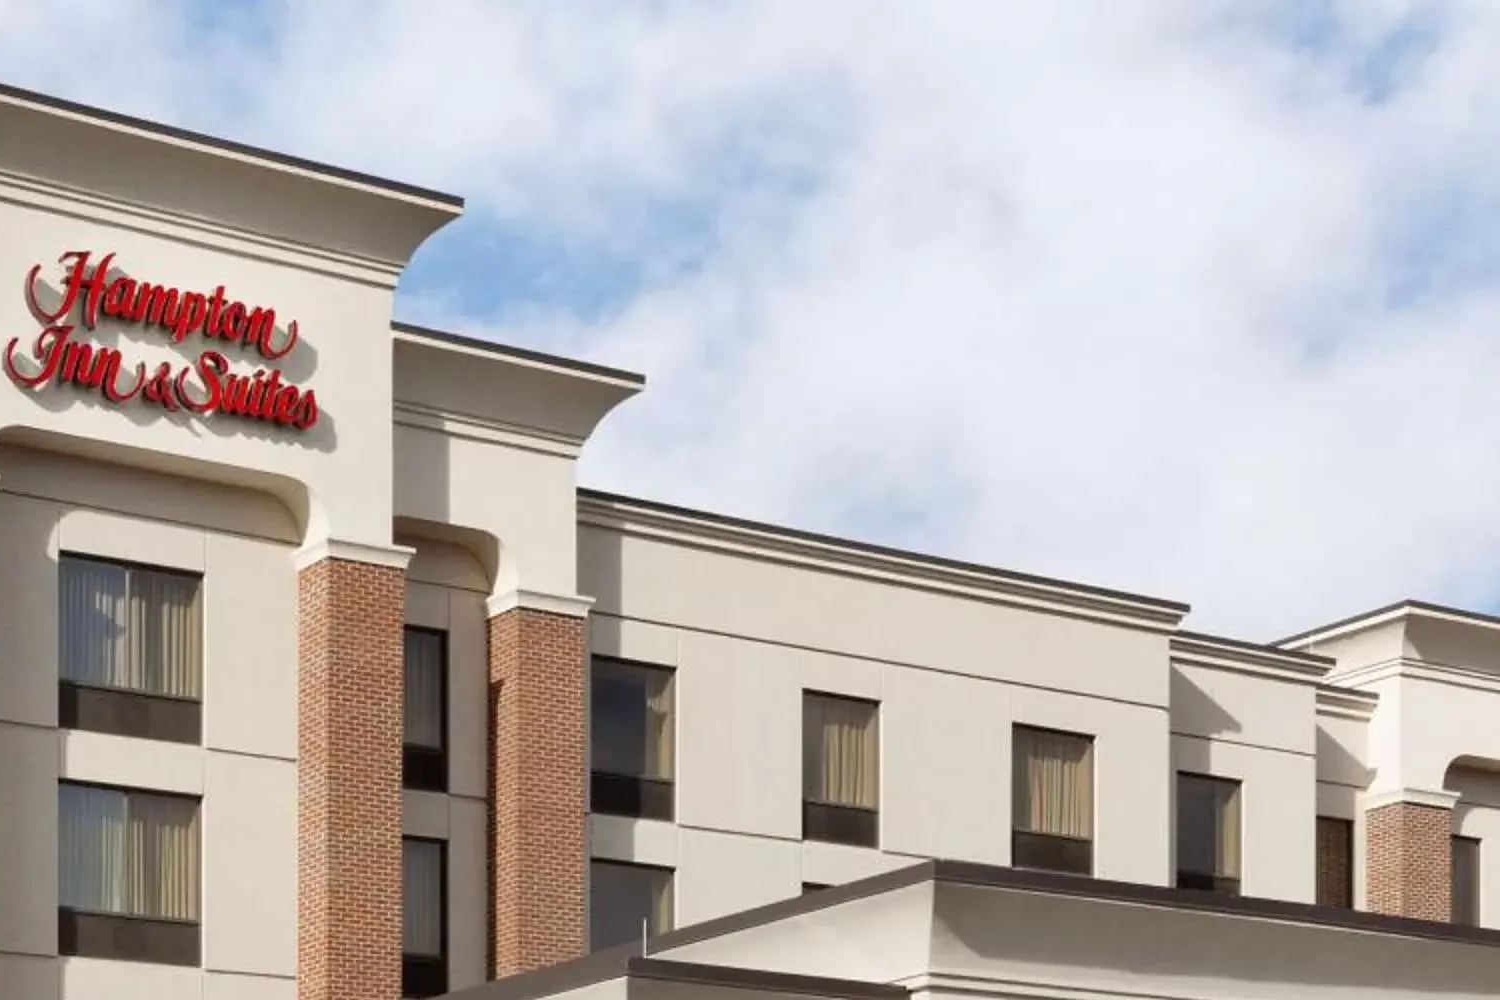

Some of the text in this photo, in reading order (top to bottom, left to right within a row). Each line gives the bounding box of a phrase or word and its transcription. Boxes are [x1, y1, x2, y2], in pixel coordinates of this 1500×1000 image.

[26, 250, 298, 359] Hampton
[6, 324, 319, 429] Inn & Suites
